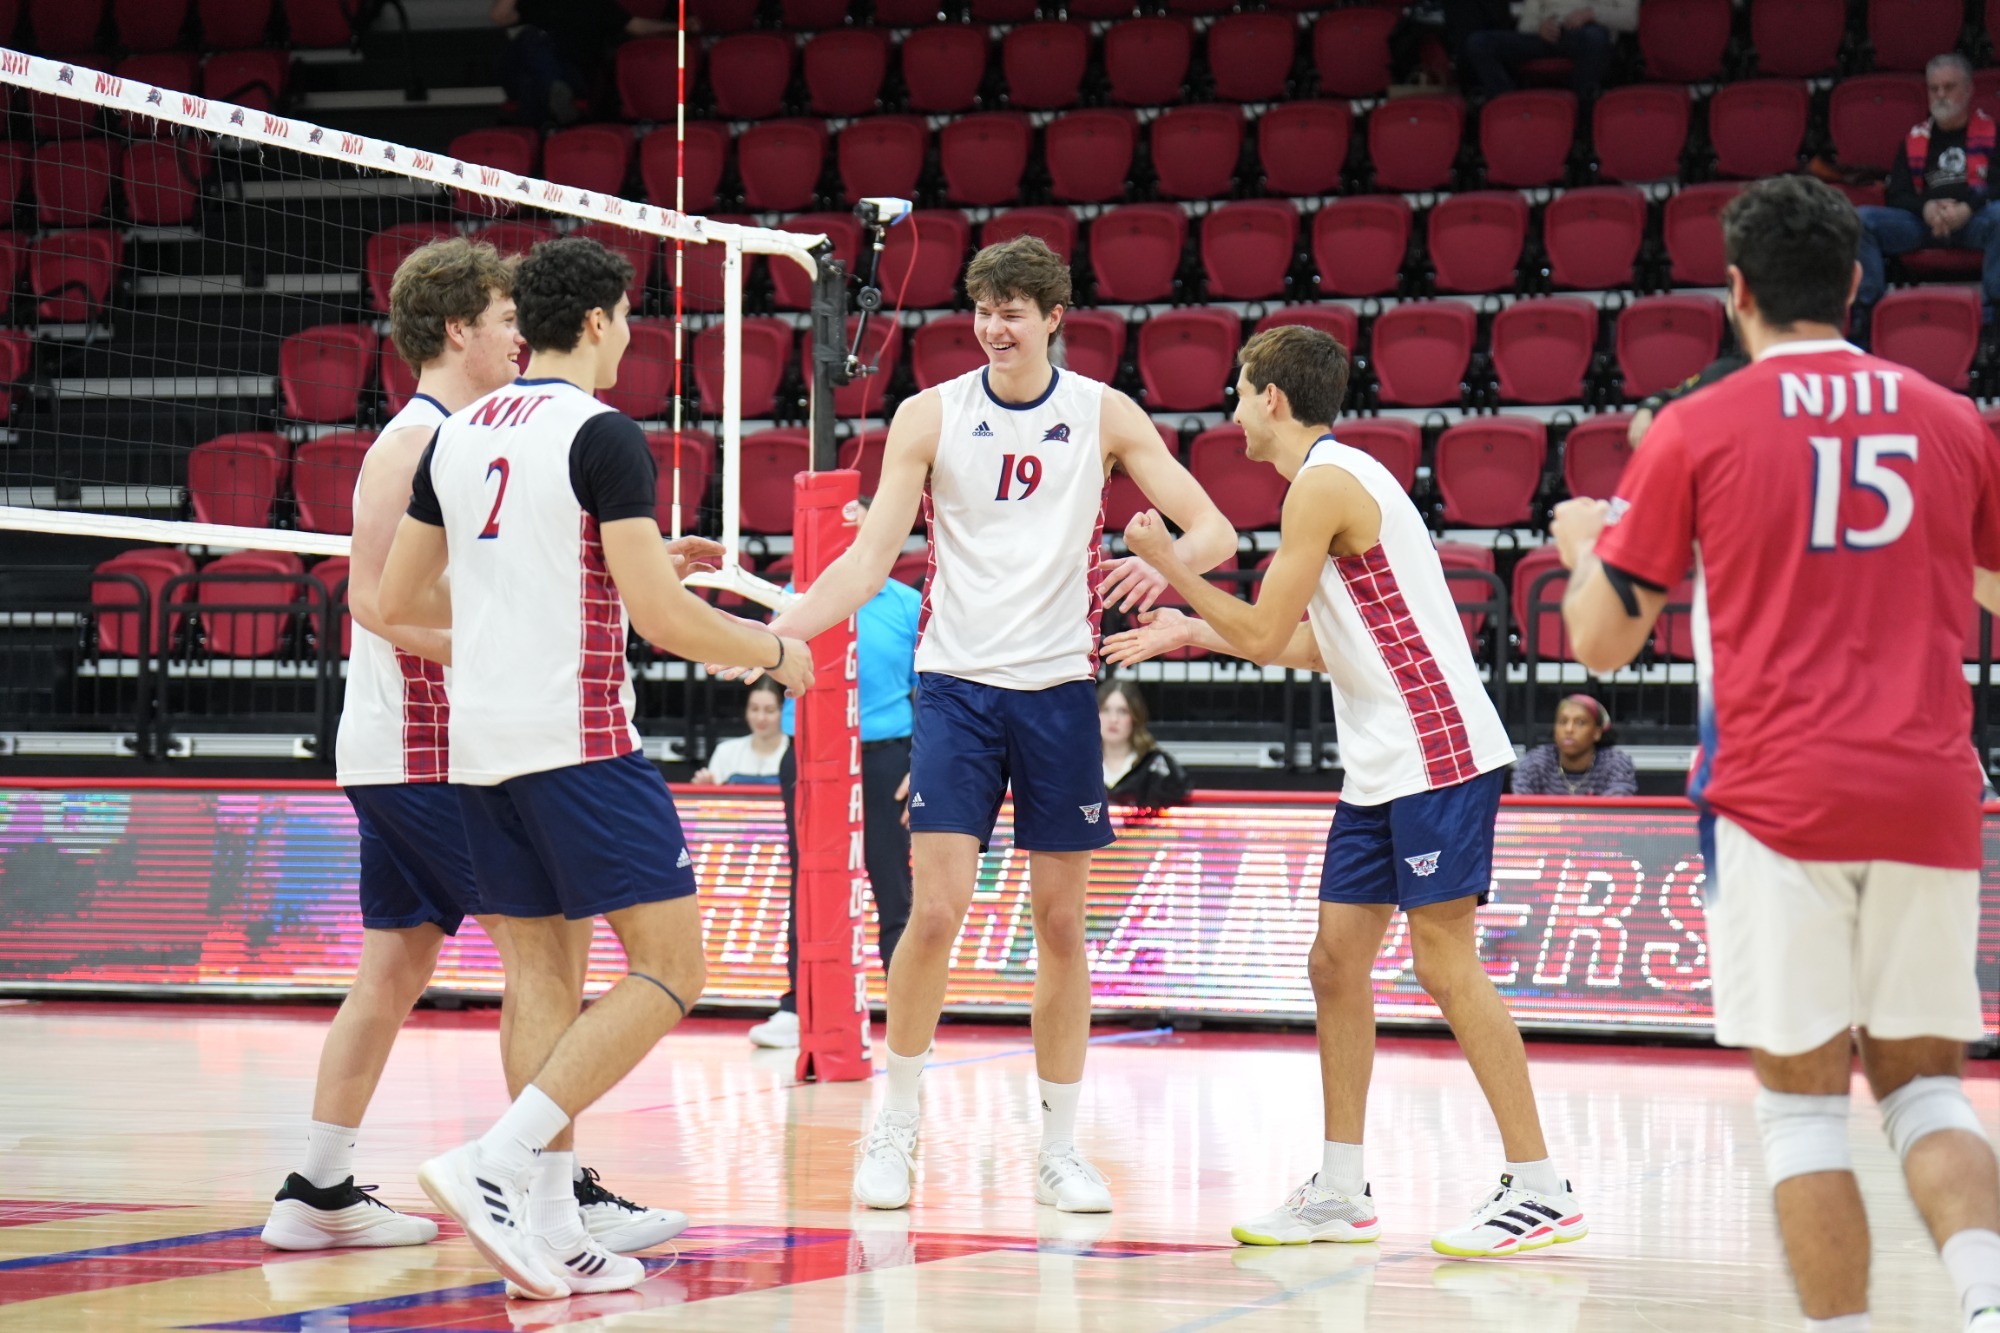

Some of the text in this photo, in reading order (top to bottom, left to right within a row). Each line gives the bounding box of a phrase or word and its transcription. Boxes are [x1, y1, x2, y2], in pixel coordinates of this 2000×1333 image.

[1, 51, 31, 76] NJIT
[95, 72, 123, 98] NJIT
[182, 95, 208, 119] NJIT
[264, 115, 289, 138] NJIT
[341, 134, 364, 156] NJIT
[412, 151, 434, 172] NJIT
[480, 166, 500, 188] NJIT
[469, 395, 555, 431] NJIT
[1779, 370, 1903, 424] NJIT
[477, 457, 510, 539] 2
[994, 454, 1043, 501] 19
[1807, 433, 1919, 554] 15
